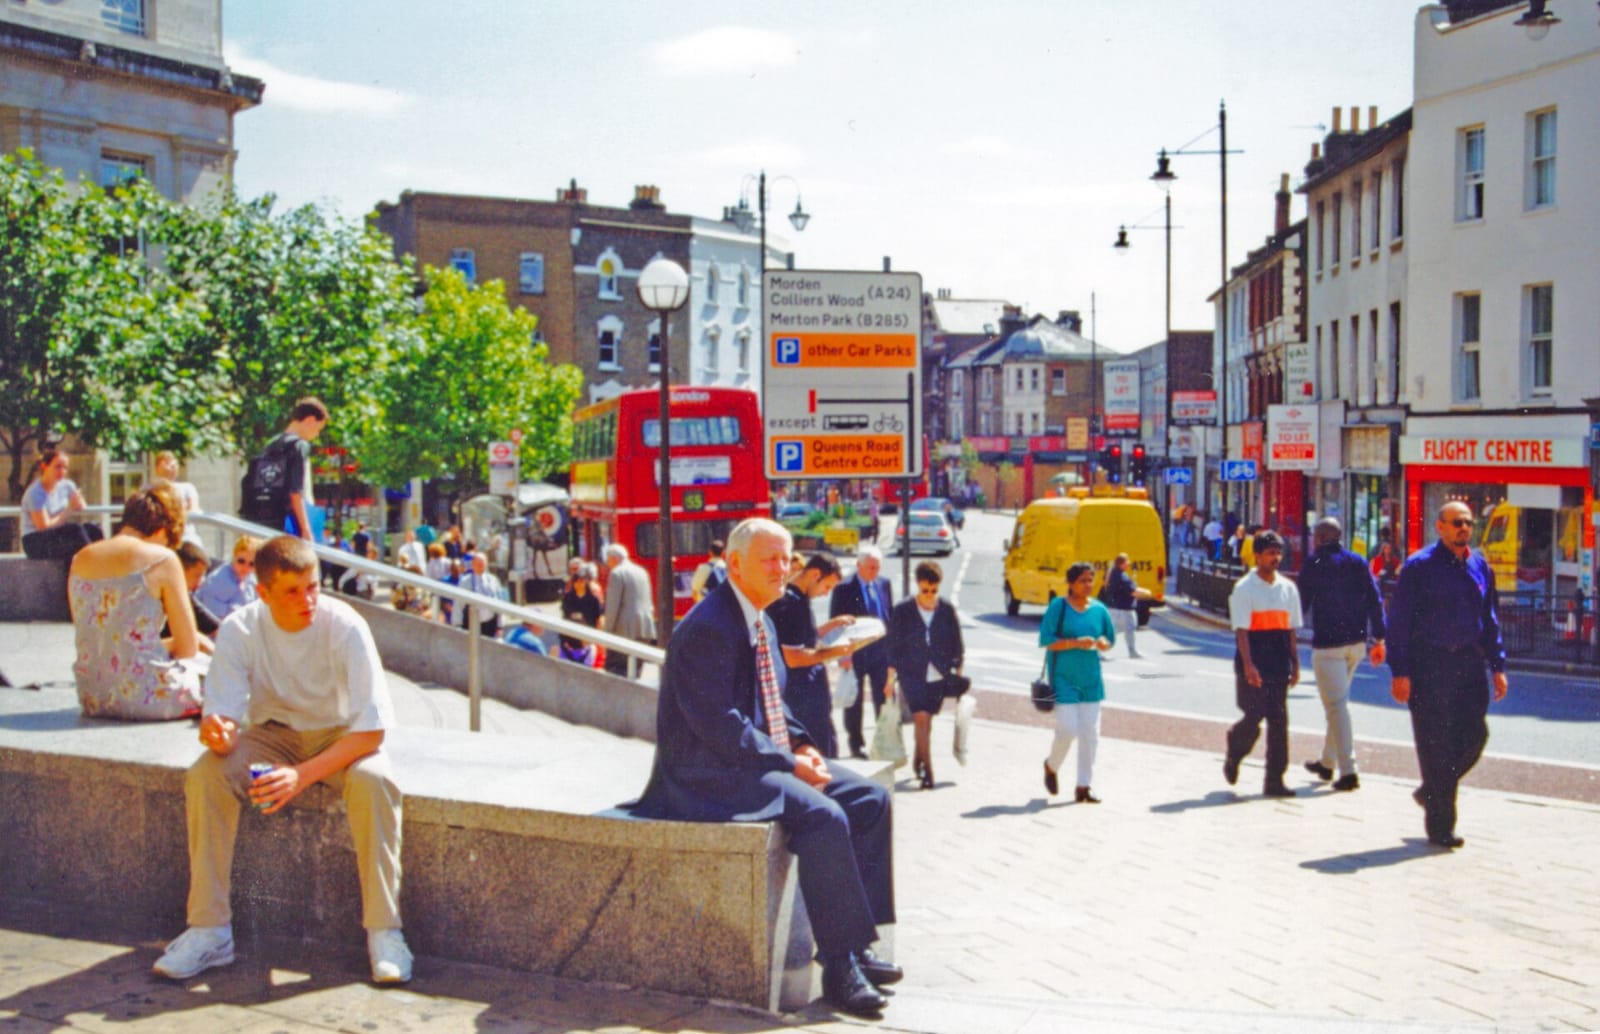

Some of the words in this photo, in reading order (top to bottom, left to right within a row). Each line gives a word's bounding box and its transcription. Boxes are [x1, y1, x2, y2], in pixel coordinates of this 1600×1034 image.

[770, 277, 821, 290] Morden
[770, 292, 824, 307] Colliers
[828, 294, 865, 307] Wood
[770, 313, 819, 326] Merton
[823, 314, 852, 326] Park
[780, 340, 798, 363] P
[807, 344, 843, 356] other
[847, 344, 870, 356] Car
[875, 344, 912, 356] Parks
[769, 417, 816, 429] except
[812, 440, 862, 452] Queens
[866, 440, 900, 452] Road
[1423, 439, 1478, 461] FLIGHT
[1484, 439, 1553, 462] CENTRE
[780, 443, 800, 470] P
[812, 456, 859, 468] Centre
[862, 455, 899, 468] Court
